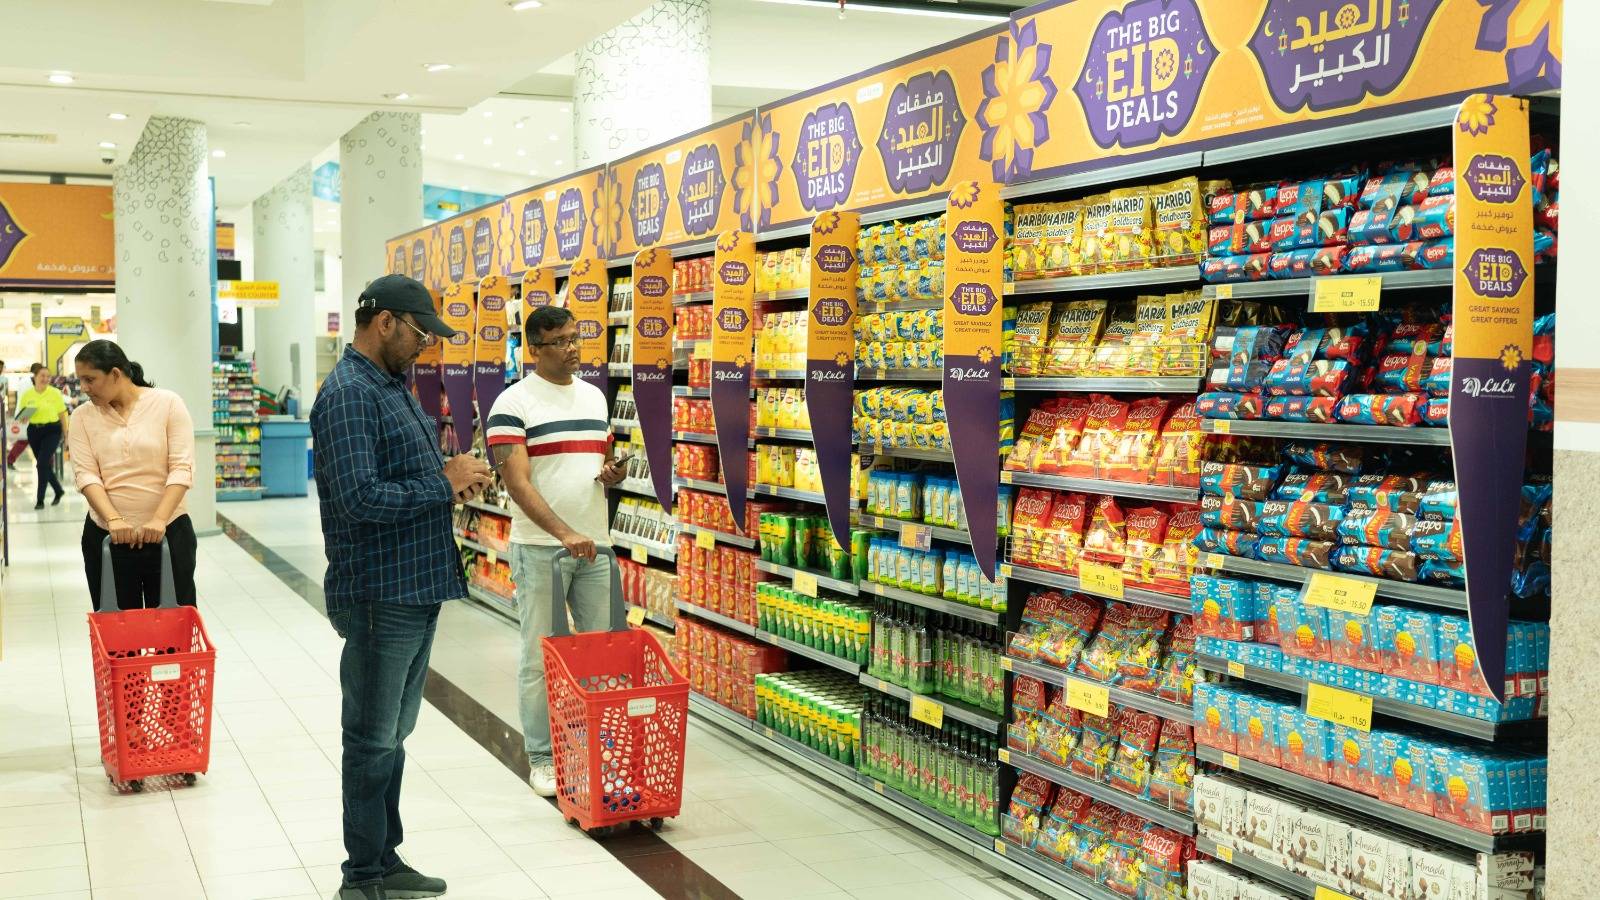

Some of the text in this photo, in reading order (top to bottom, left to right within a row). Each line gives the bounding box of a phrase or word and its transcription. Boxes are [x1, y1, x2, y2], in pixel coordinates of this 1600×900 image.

[1107, 10, 1180, 49] THE BIG
[1106, 37, 1180, 102] EID
[1289, 34, 1390, 94] الكبير
[897, 90, 943, 115] صفقات
[1106, 90, 1178, 131] DEALS
[808, 116, 845, 139] THE BIG
[896, 106, 943, 153] العيد
[808, 135, 845, 178] EID
[896, 144, 942, 181] الكبير
[1477, 162, 1511, 170] صفقات
[638, 173, 660, 187] THE BIG
[808, 173, 844, 199] DEALS
[1477, 170, 1511, 186] العيد
[1478, 185, 1512, 196] الكبير
[638, 187, 660, 221] EID
[1111, 197, 1144, 213] HARIBO
[1156, 190, 1191, 210] HARIBO
[525, 219, 541, 246] EID
[638, 218, 660, 237] DEALS
[525, 244, 542, 259] DEALS
[1479, 254, 1512, 263] THE BIG
[1479, 262, 1512, 281] EID
[975, 286, 987, 294] BIG
[1480, 281, 1512, 292] DEALS
[961, 292, 987, 305] EID
[1360, 299, 1375, 307] 15.50
[822, 306, 844, 317] EID
[961, 304, 987, 312] DEALS
[1061, 309, 1098, 323] HARIBO
[1171, 300, 1205, 318] HARIBO
[1469, 305, 1520, 314] GREAT SAVINGS
[644, 322, 663, 331] EID
[724, 315, 742, 325] EID
[824, 370, 845, 379] LuLu
[964, 367, 990, 378] LuLu
[1480, 377, 1516, 393] LuLu
[1351, 600, 1367, 609] 15.50
[1352, 716, 1367, 727] 11.50
[1196, 782, 1221, 798] Amada
[1248, 798, 1273, 814] Amada
[1295, 816, 1322, 833] Amada
[1354, 836, 1383, 855] Amada
[1415, 857, 1446, 877] Amada
